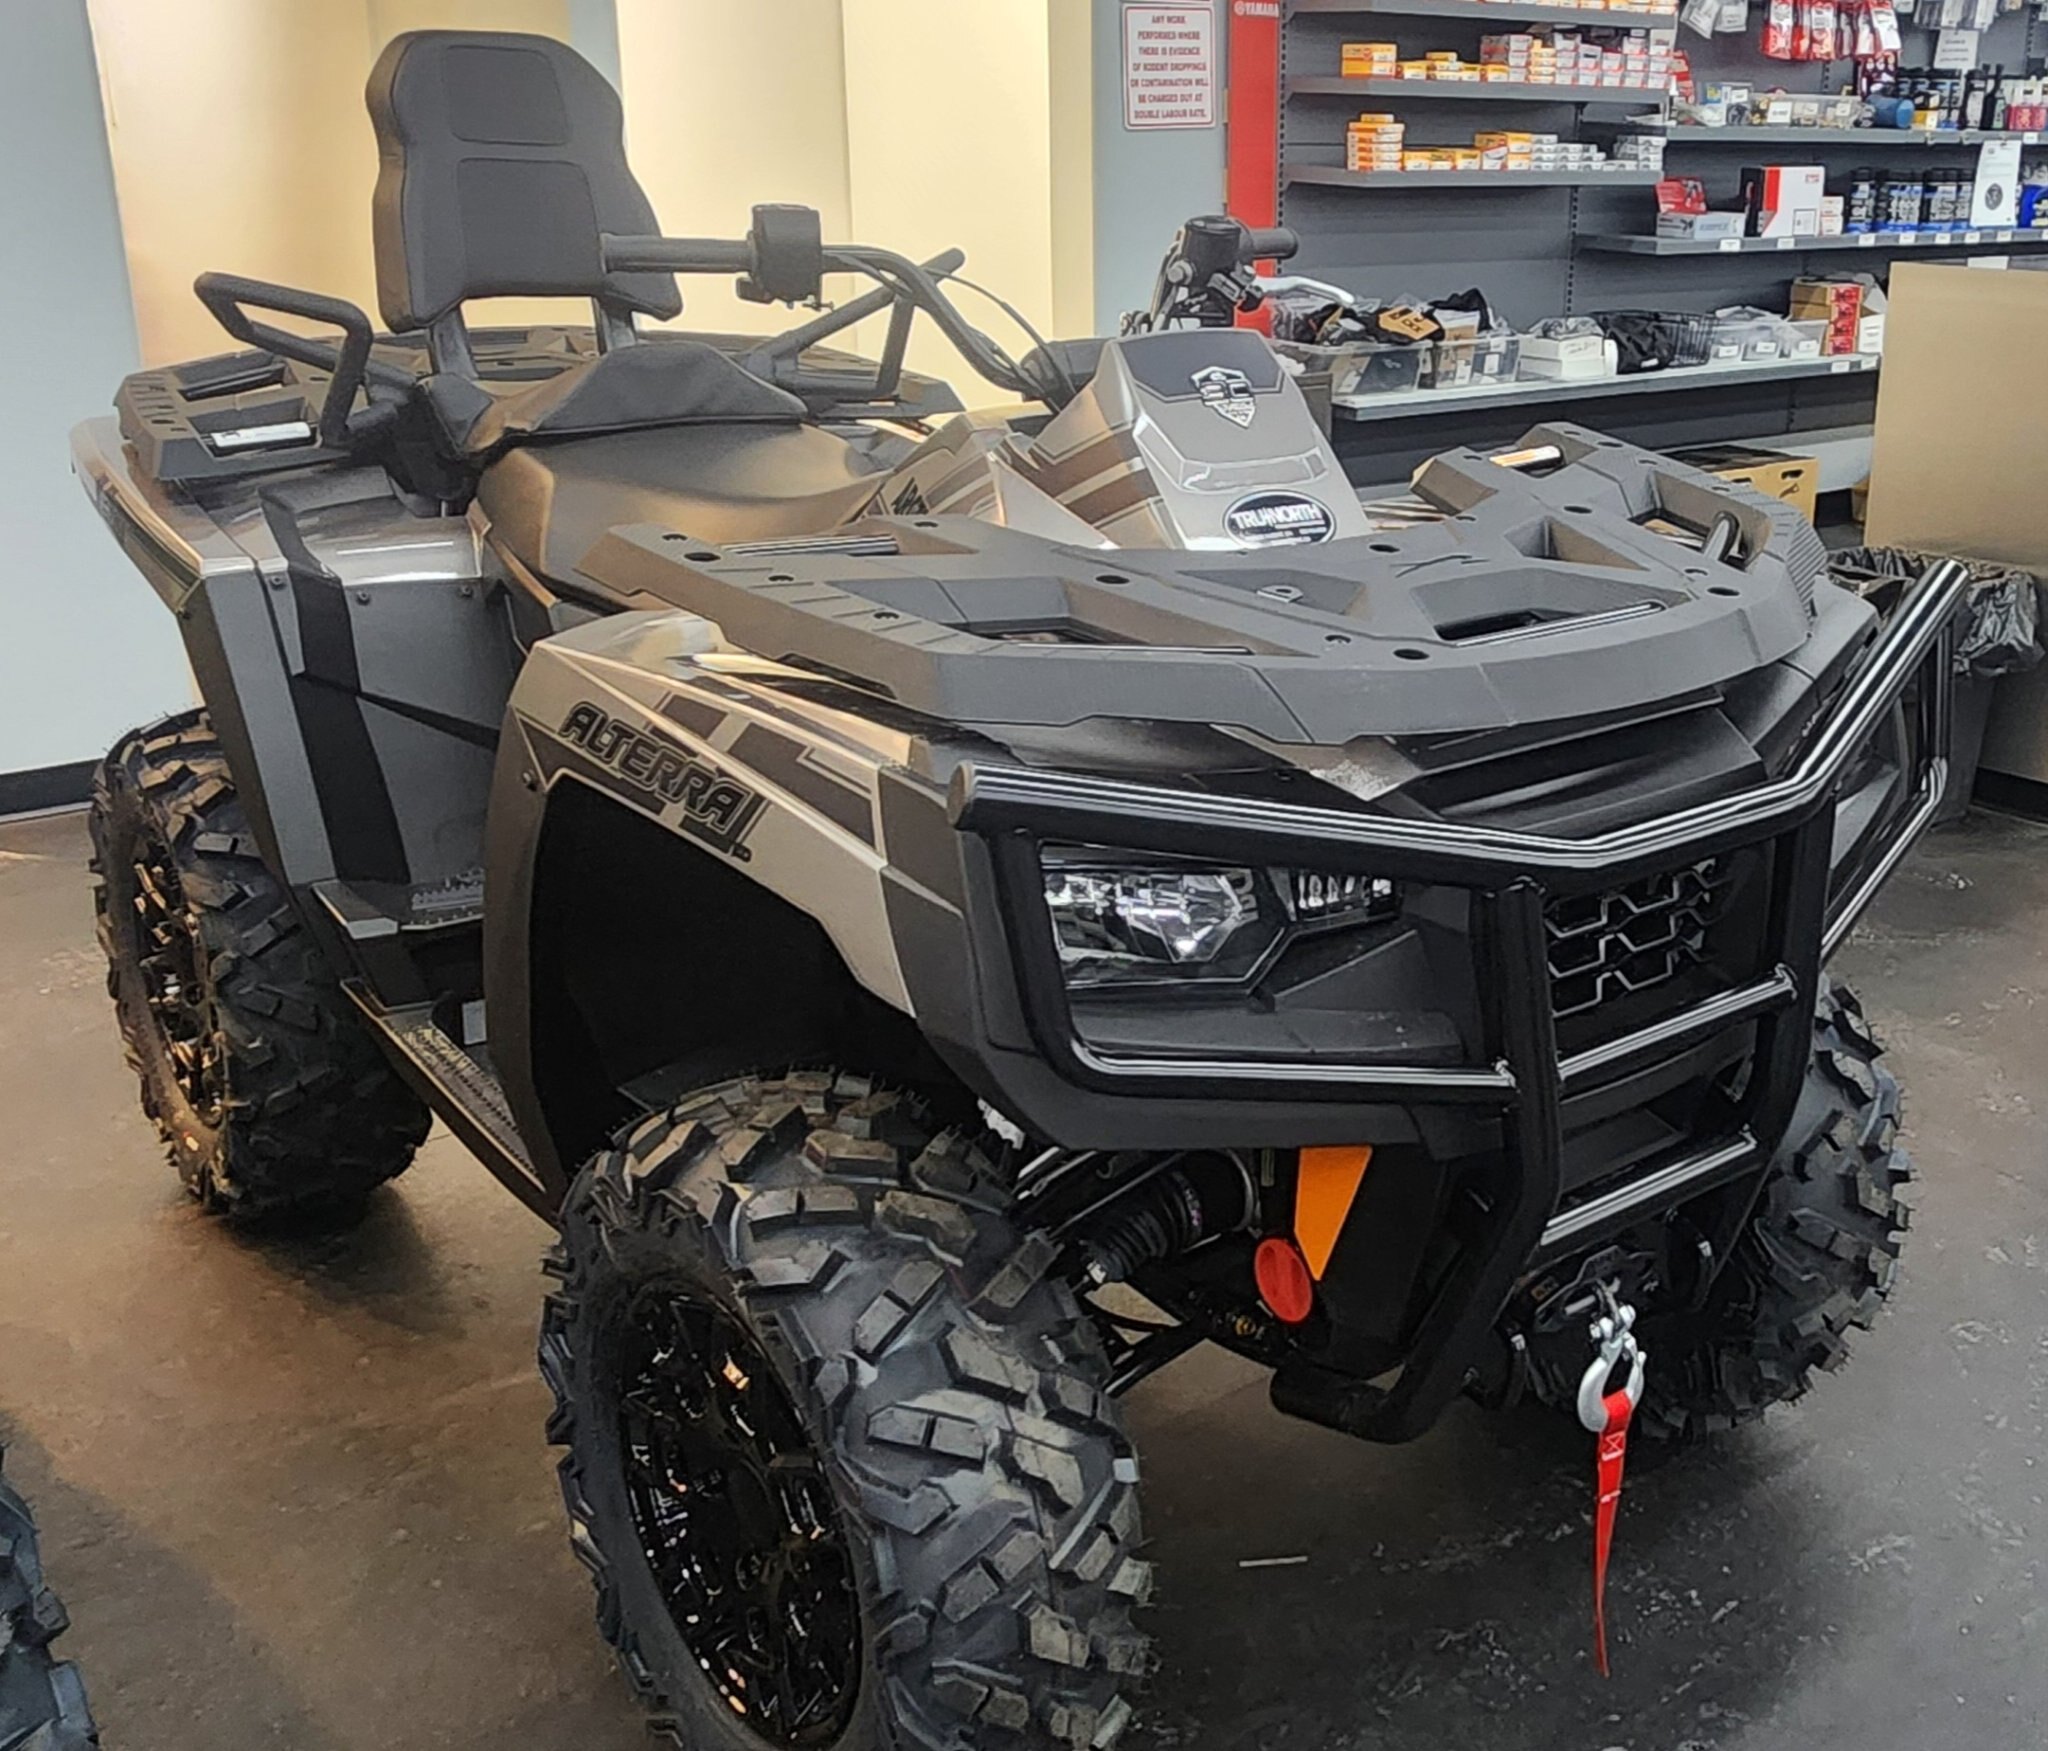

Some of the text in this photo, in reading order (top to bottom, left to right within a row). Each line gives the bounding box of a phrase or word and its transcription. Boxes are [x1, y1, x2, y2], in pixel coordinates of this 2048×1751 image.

[1245, 2, 1279, 17] YAMAHA
[1151, 15, 1186, 24] ANY WORK
[1137, 31, 1200, 40] PERFORMED WHERE
[1138, 46, 1200, 56] THERE IS EVIDENCE
[1132, 62, 1206, 72] OF RODENT DROPPINGS
[1130, 78, 1208, 87] OR CONTAMINATION WILL
[1138, 93, 1203, 103] BE CHARGED OUT AT
[1134, 110, 1159, 119] DOUBLE
[1161, 109, 1187, 118] LABOUR
[556, 701, 752, 835] ALTERRA
